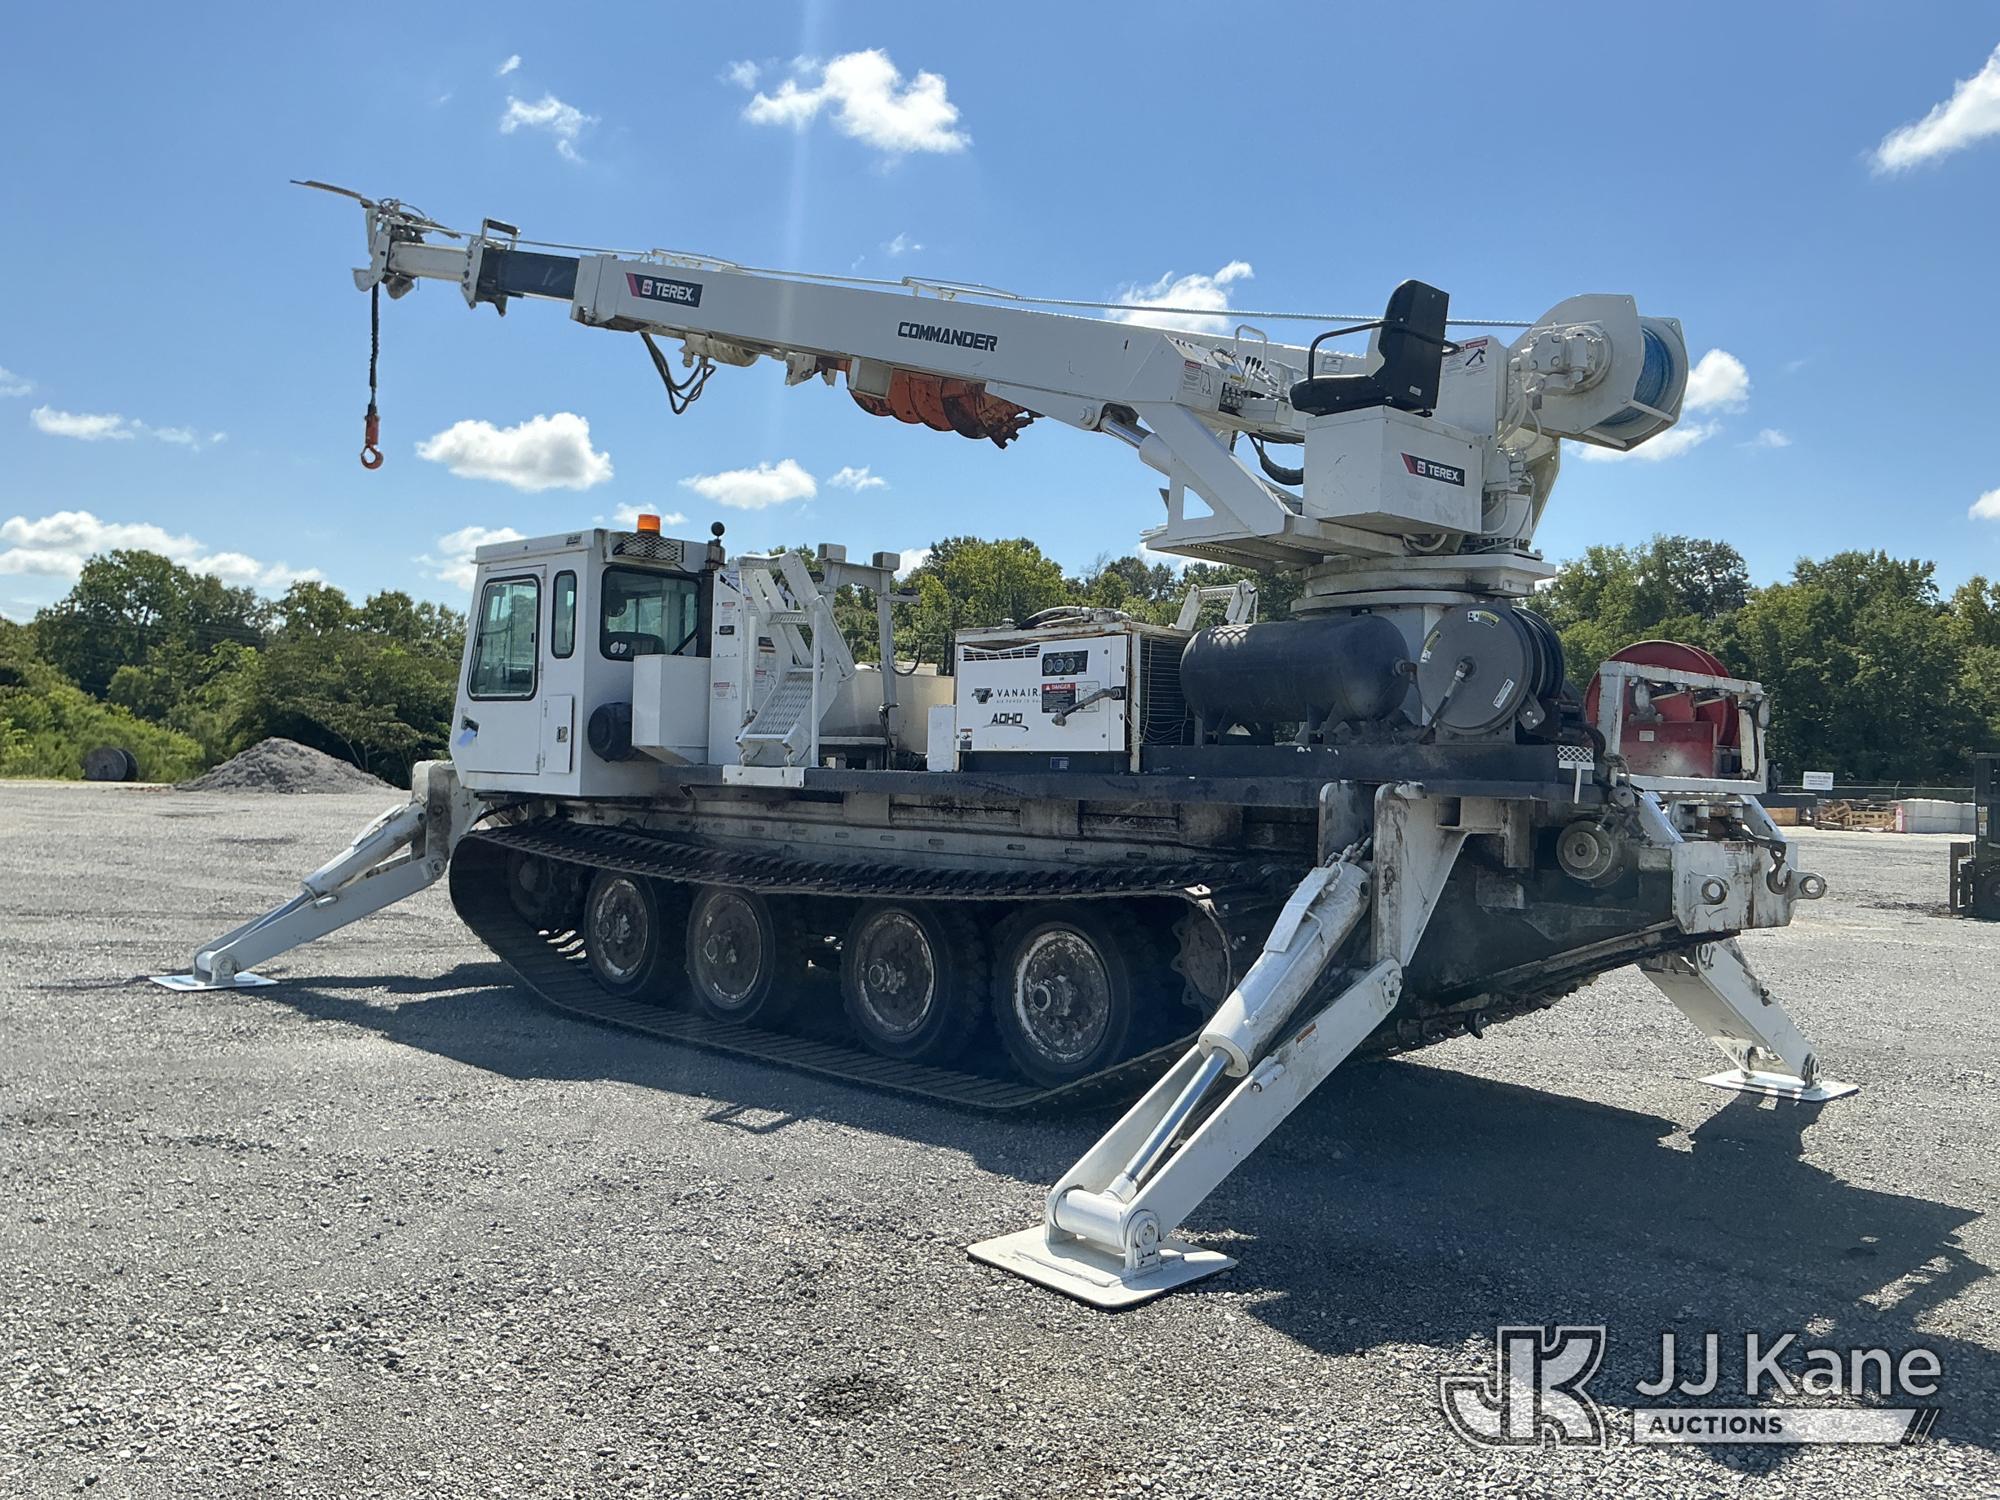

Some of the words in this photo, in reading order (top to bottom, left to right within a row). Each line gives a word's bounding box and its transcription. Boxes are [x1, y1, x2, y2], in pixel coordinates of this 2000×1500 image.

[655, 282, 694, 302] TEREX
[897, 321, 998, 352] COMMANDER
[1428, 464, 1459, 482] TEREX
[996, 687, 1039, 698] VANAIR
